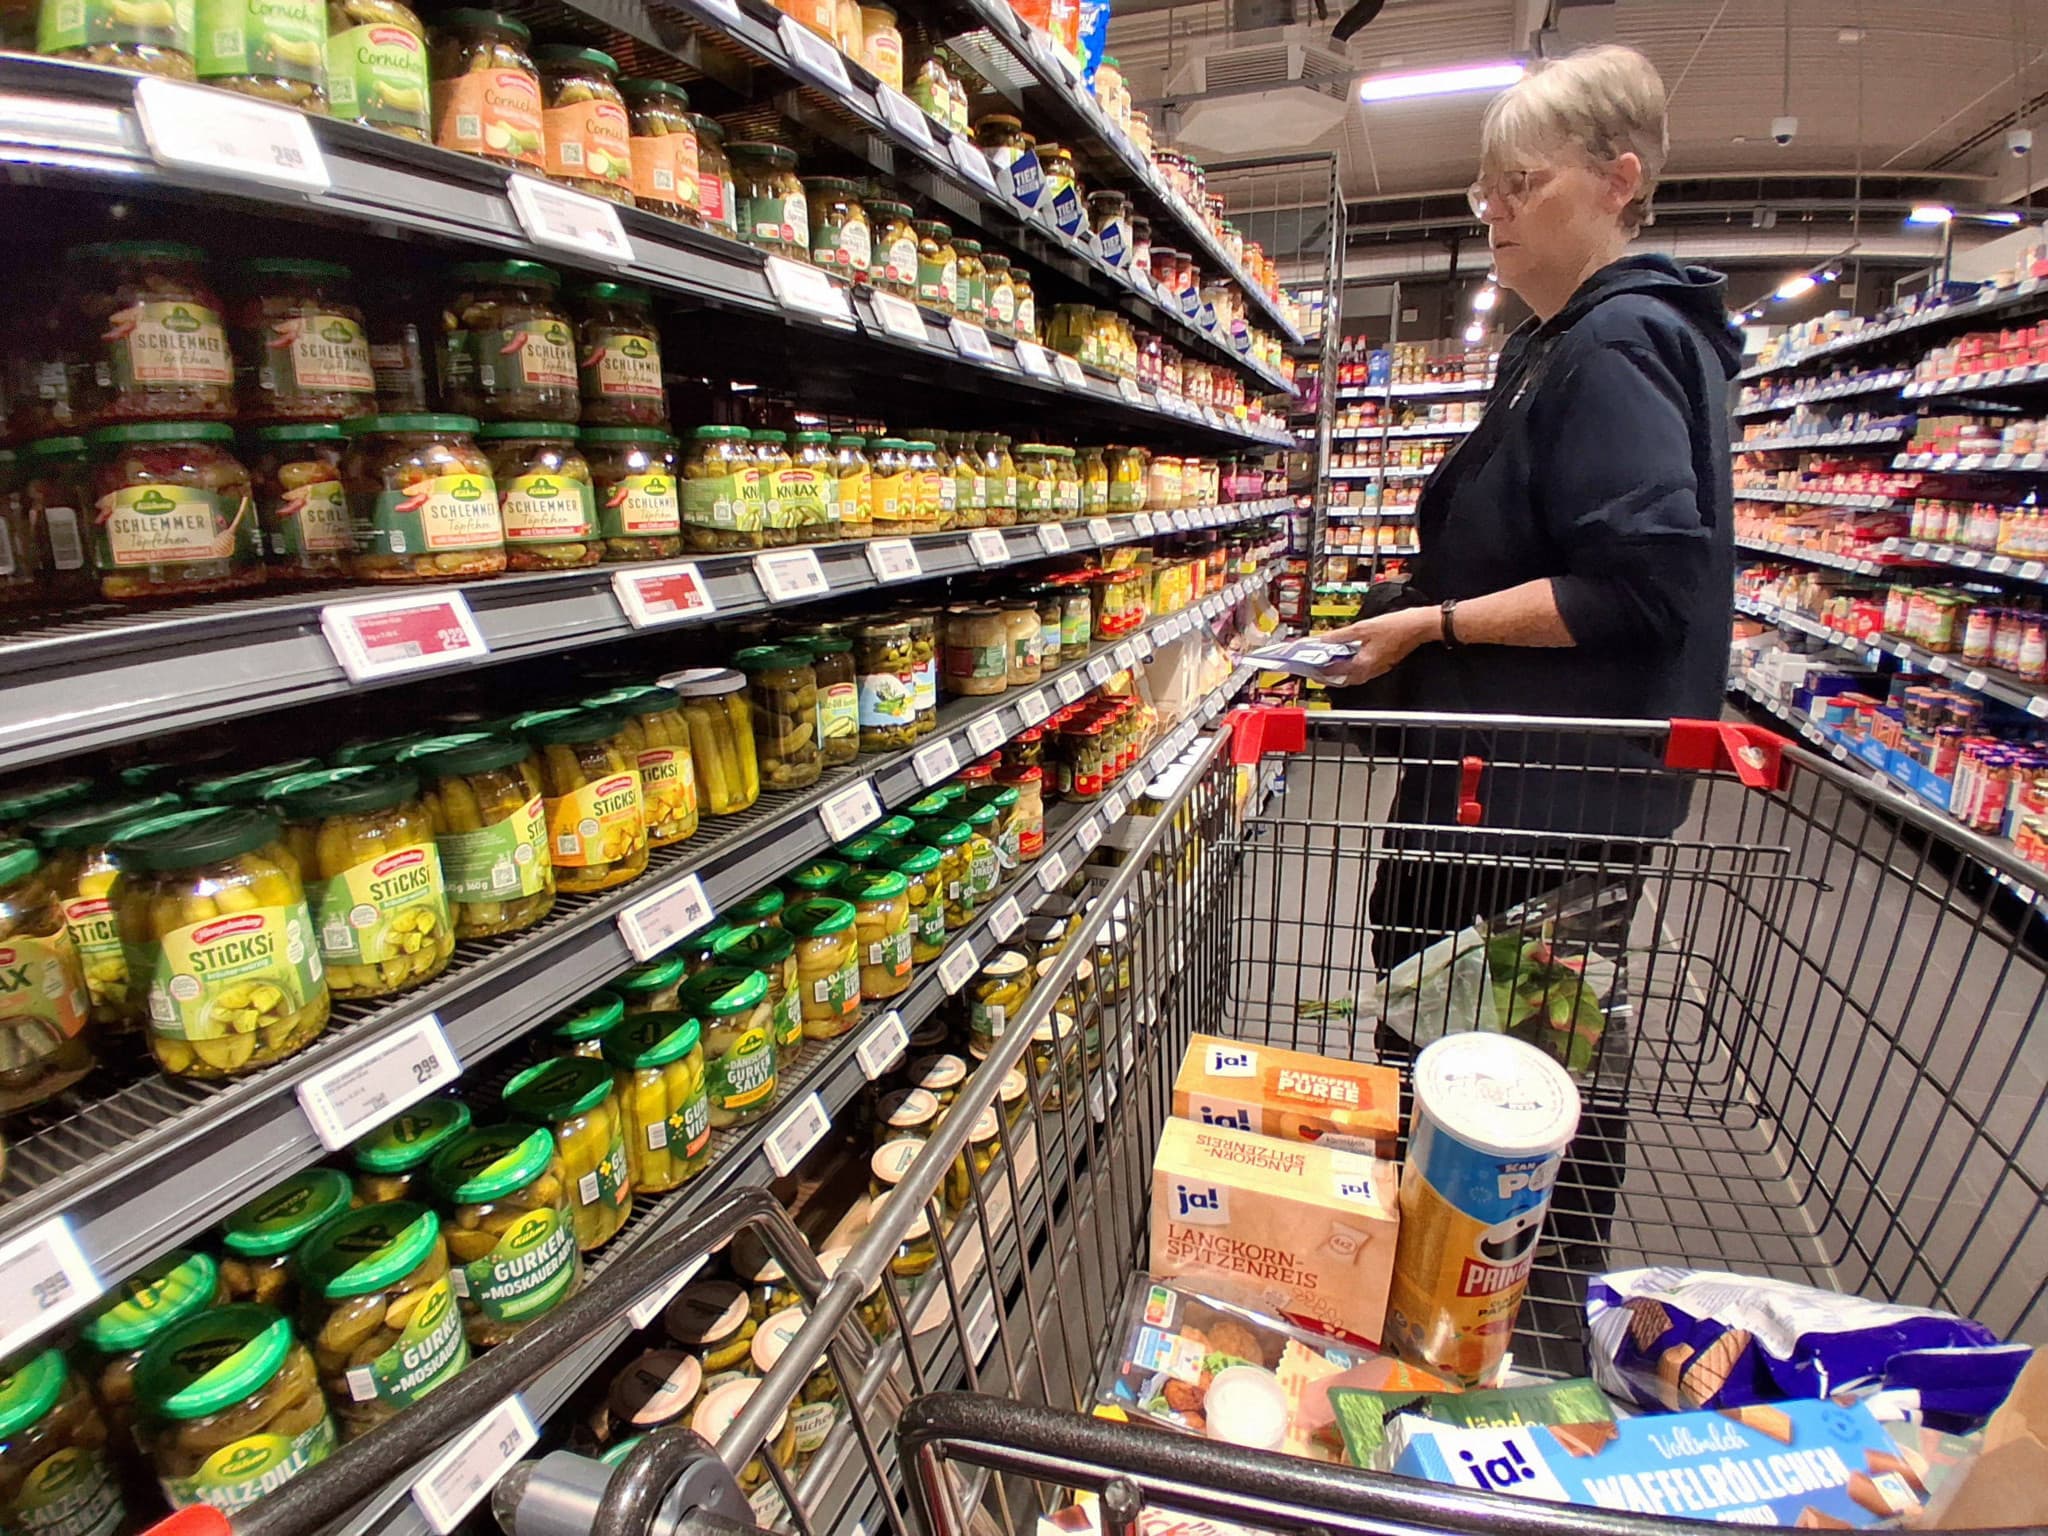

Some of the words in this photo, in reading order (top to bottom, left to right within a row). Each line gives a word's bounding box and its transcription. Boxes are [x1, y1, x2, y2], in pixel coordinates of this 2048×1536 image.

[114, 514, 206, 535] SCHLEMMER
[1214, 1052, 1249, 1071] ja!
[1279, 1069, 1358, 1090] KARTOFFEL
[1277, 1077, 1360, 1104] PÜREE
[1176, 1184, 1220, 1216] ja!
[494, 1225, 565, 1282] GURKEN
[1165, 1240, 1319, 1290] SPITZENREIS
[1167, 1223, 1305, 1269] LANGKORN-
[1647, 1422, 1750, 1460] Vollmilch
[1458, 1439, 1537, 1491] ja!
[1581, 1446, 1852, 1517] WAFFELRÖLLCHEN
